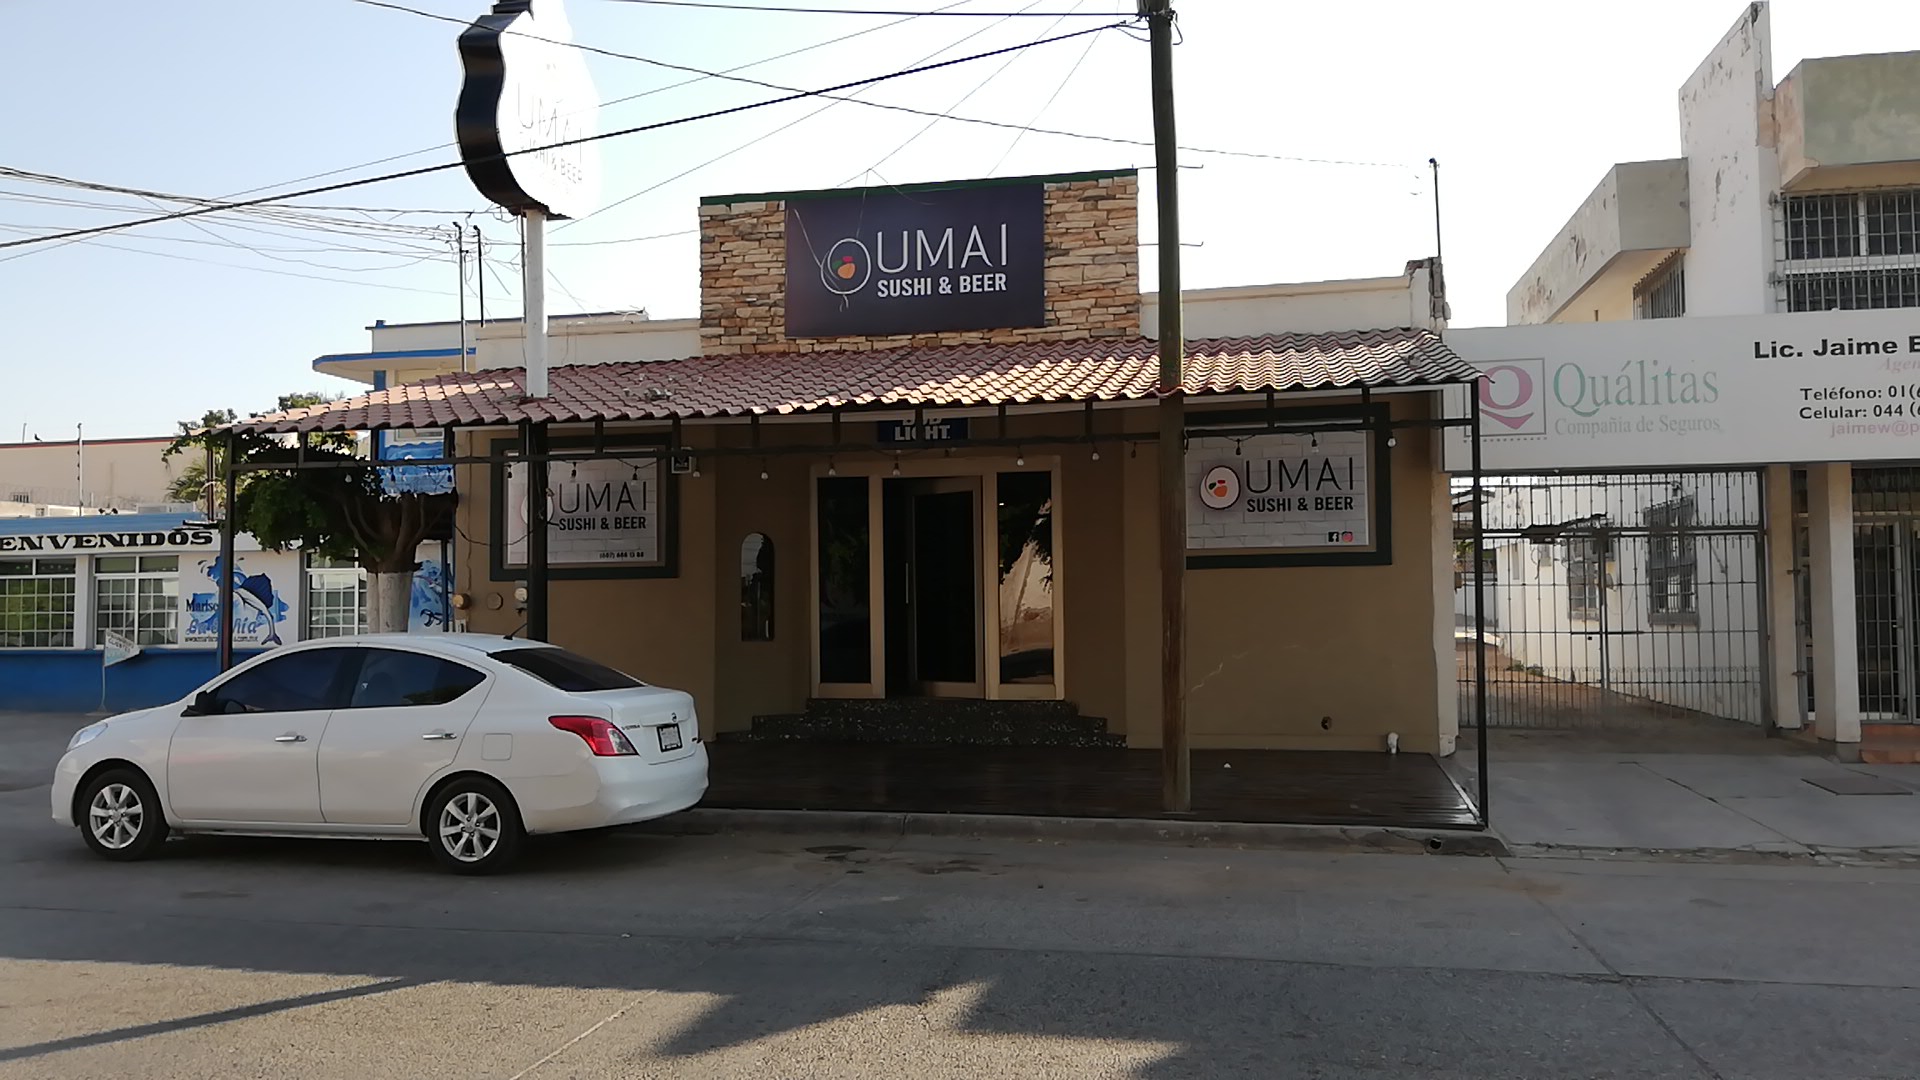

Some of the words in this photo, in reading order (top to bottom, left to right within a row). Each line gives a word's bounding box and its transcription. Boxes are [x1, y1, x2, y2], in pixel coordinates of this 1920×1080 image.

[876, 223, 1008, 274] UMAI
[876, 276, 932, 298] SUSHI
[938, 276, 952, 295] &
[959, 273, 1007, 294] BEER
[1754, 340, 1804, 359] Lic.
[1812, 338, 1898, 356] Jaime
[1552, 359, 1720, 418] Quálitas
[1800, 386, 1882, 401] Teléfono:
[1799, 405, 1867, 419] Celular:
[1873, 403, 1903, 418] 044
[1635, 415, 1654, 433] de
[1658, 414, 1721, 436] Seguros
[1245, 457, 1354, 494] UMAI
[558, 481, 648, 514] UMAI
[1246, 498, 1292, 513] SUSHI
[1297, 498, 1309, 511] &
[1314, 496, 1354, 511] BEER
[558, 517, 596, 531] SUSHI
[600, 517, 610, 530] &
[614, 516, 647, 530] BEER
